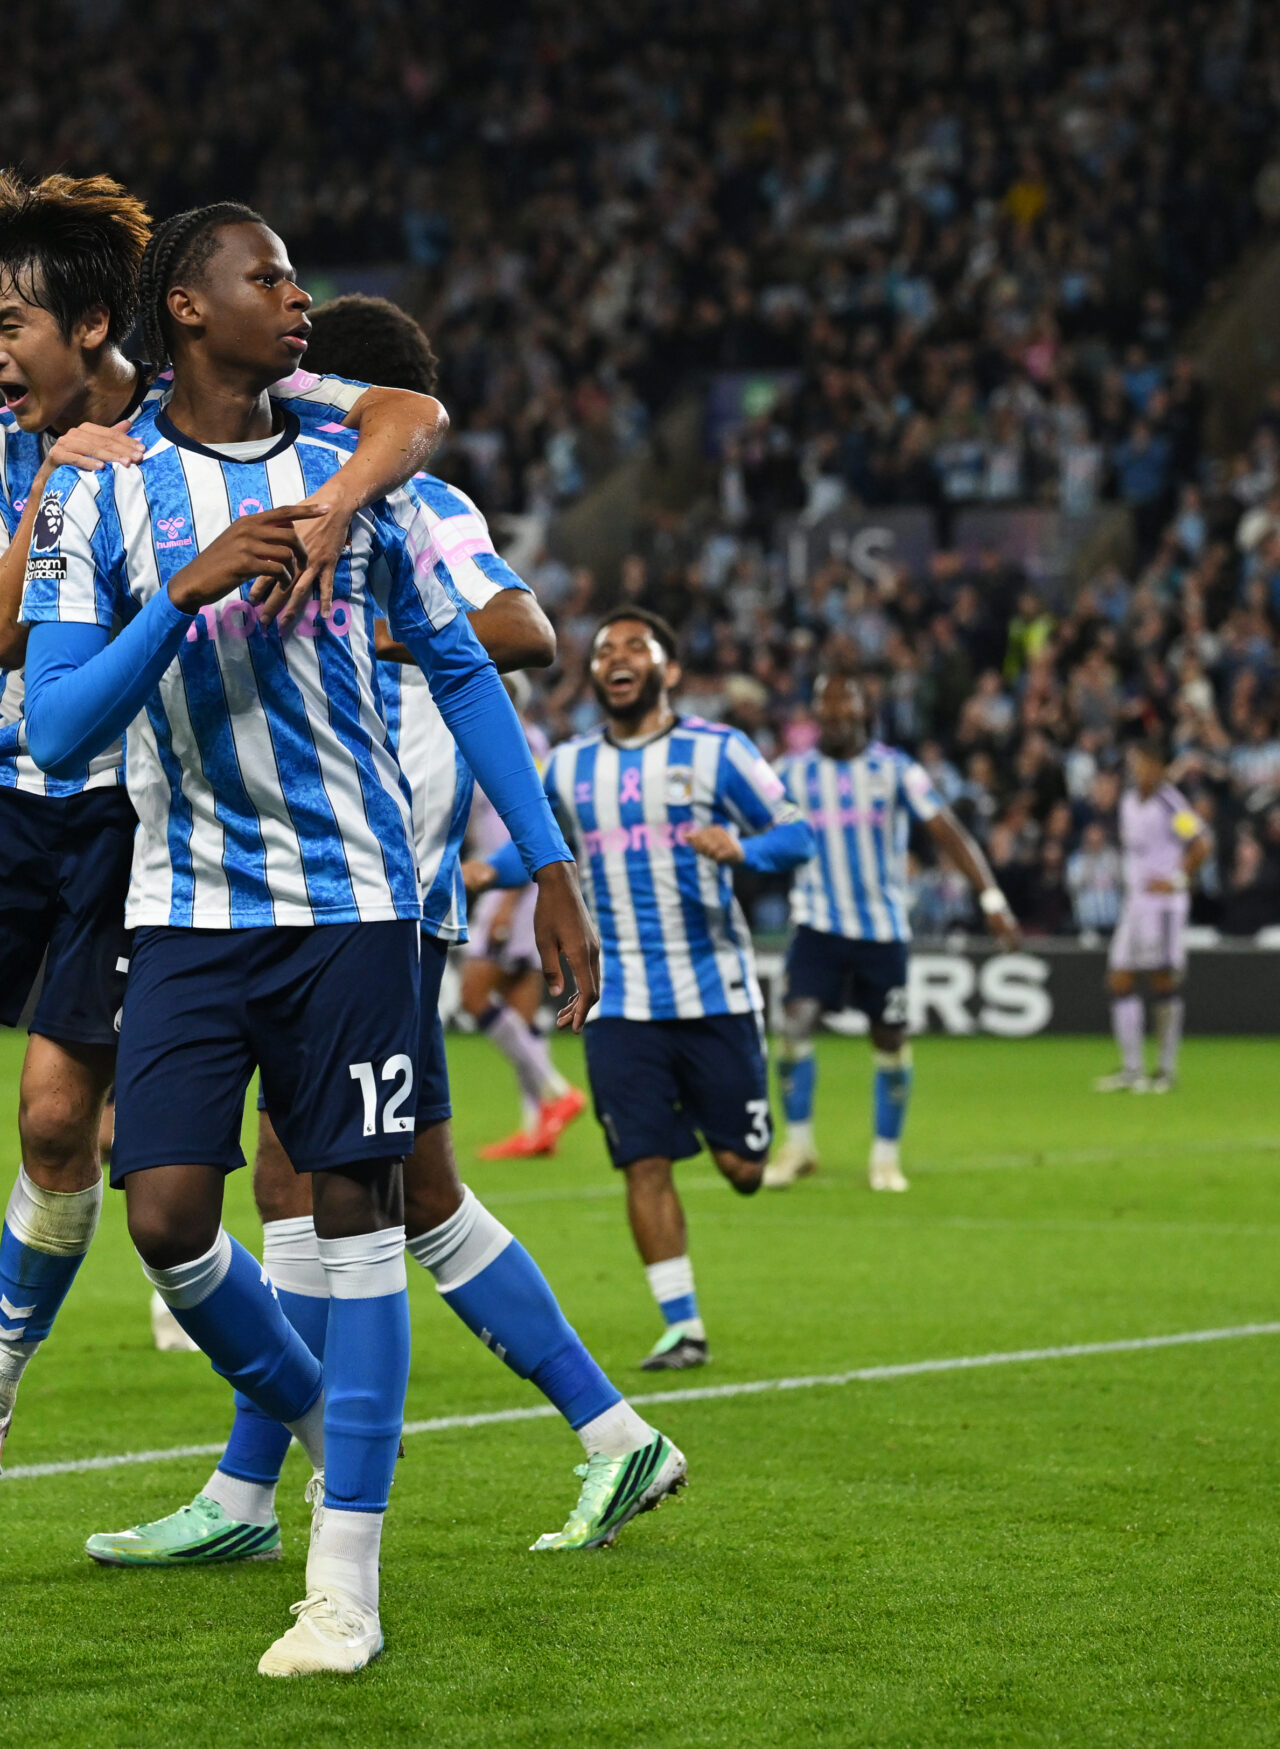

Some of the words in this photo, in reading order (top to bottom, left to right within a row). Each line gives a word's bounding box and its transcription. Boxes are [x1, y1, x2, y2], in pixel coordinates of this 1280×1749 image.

[156, 536, 193, 550] hummel
[36, 559, 61, 570] room
[35, 569, 66, 579] racism
[349, 1053, 415, 1136] 12
[745, 1099, 770, 1151] 3
